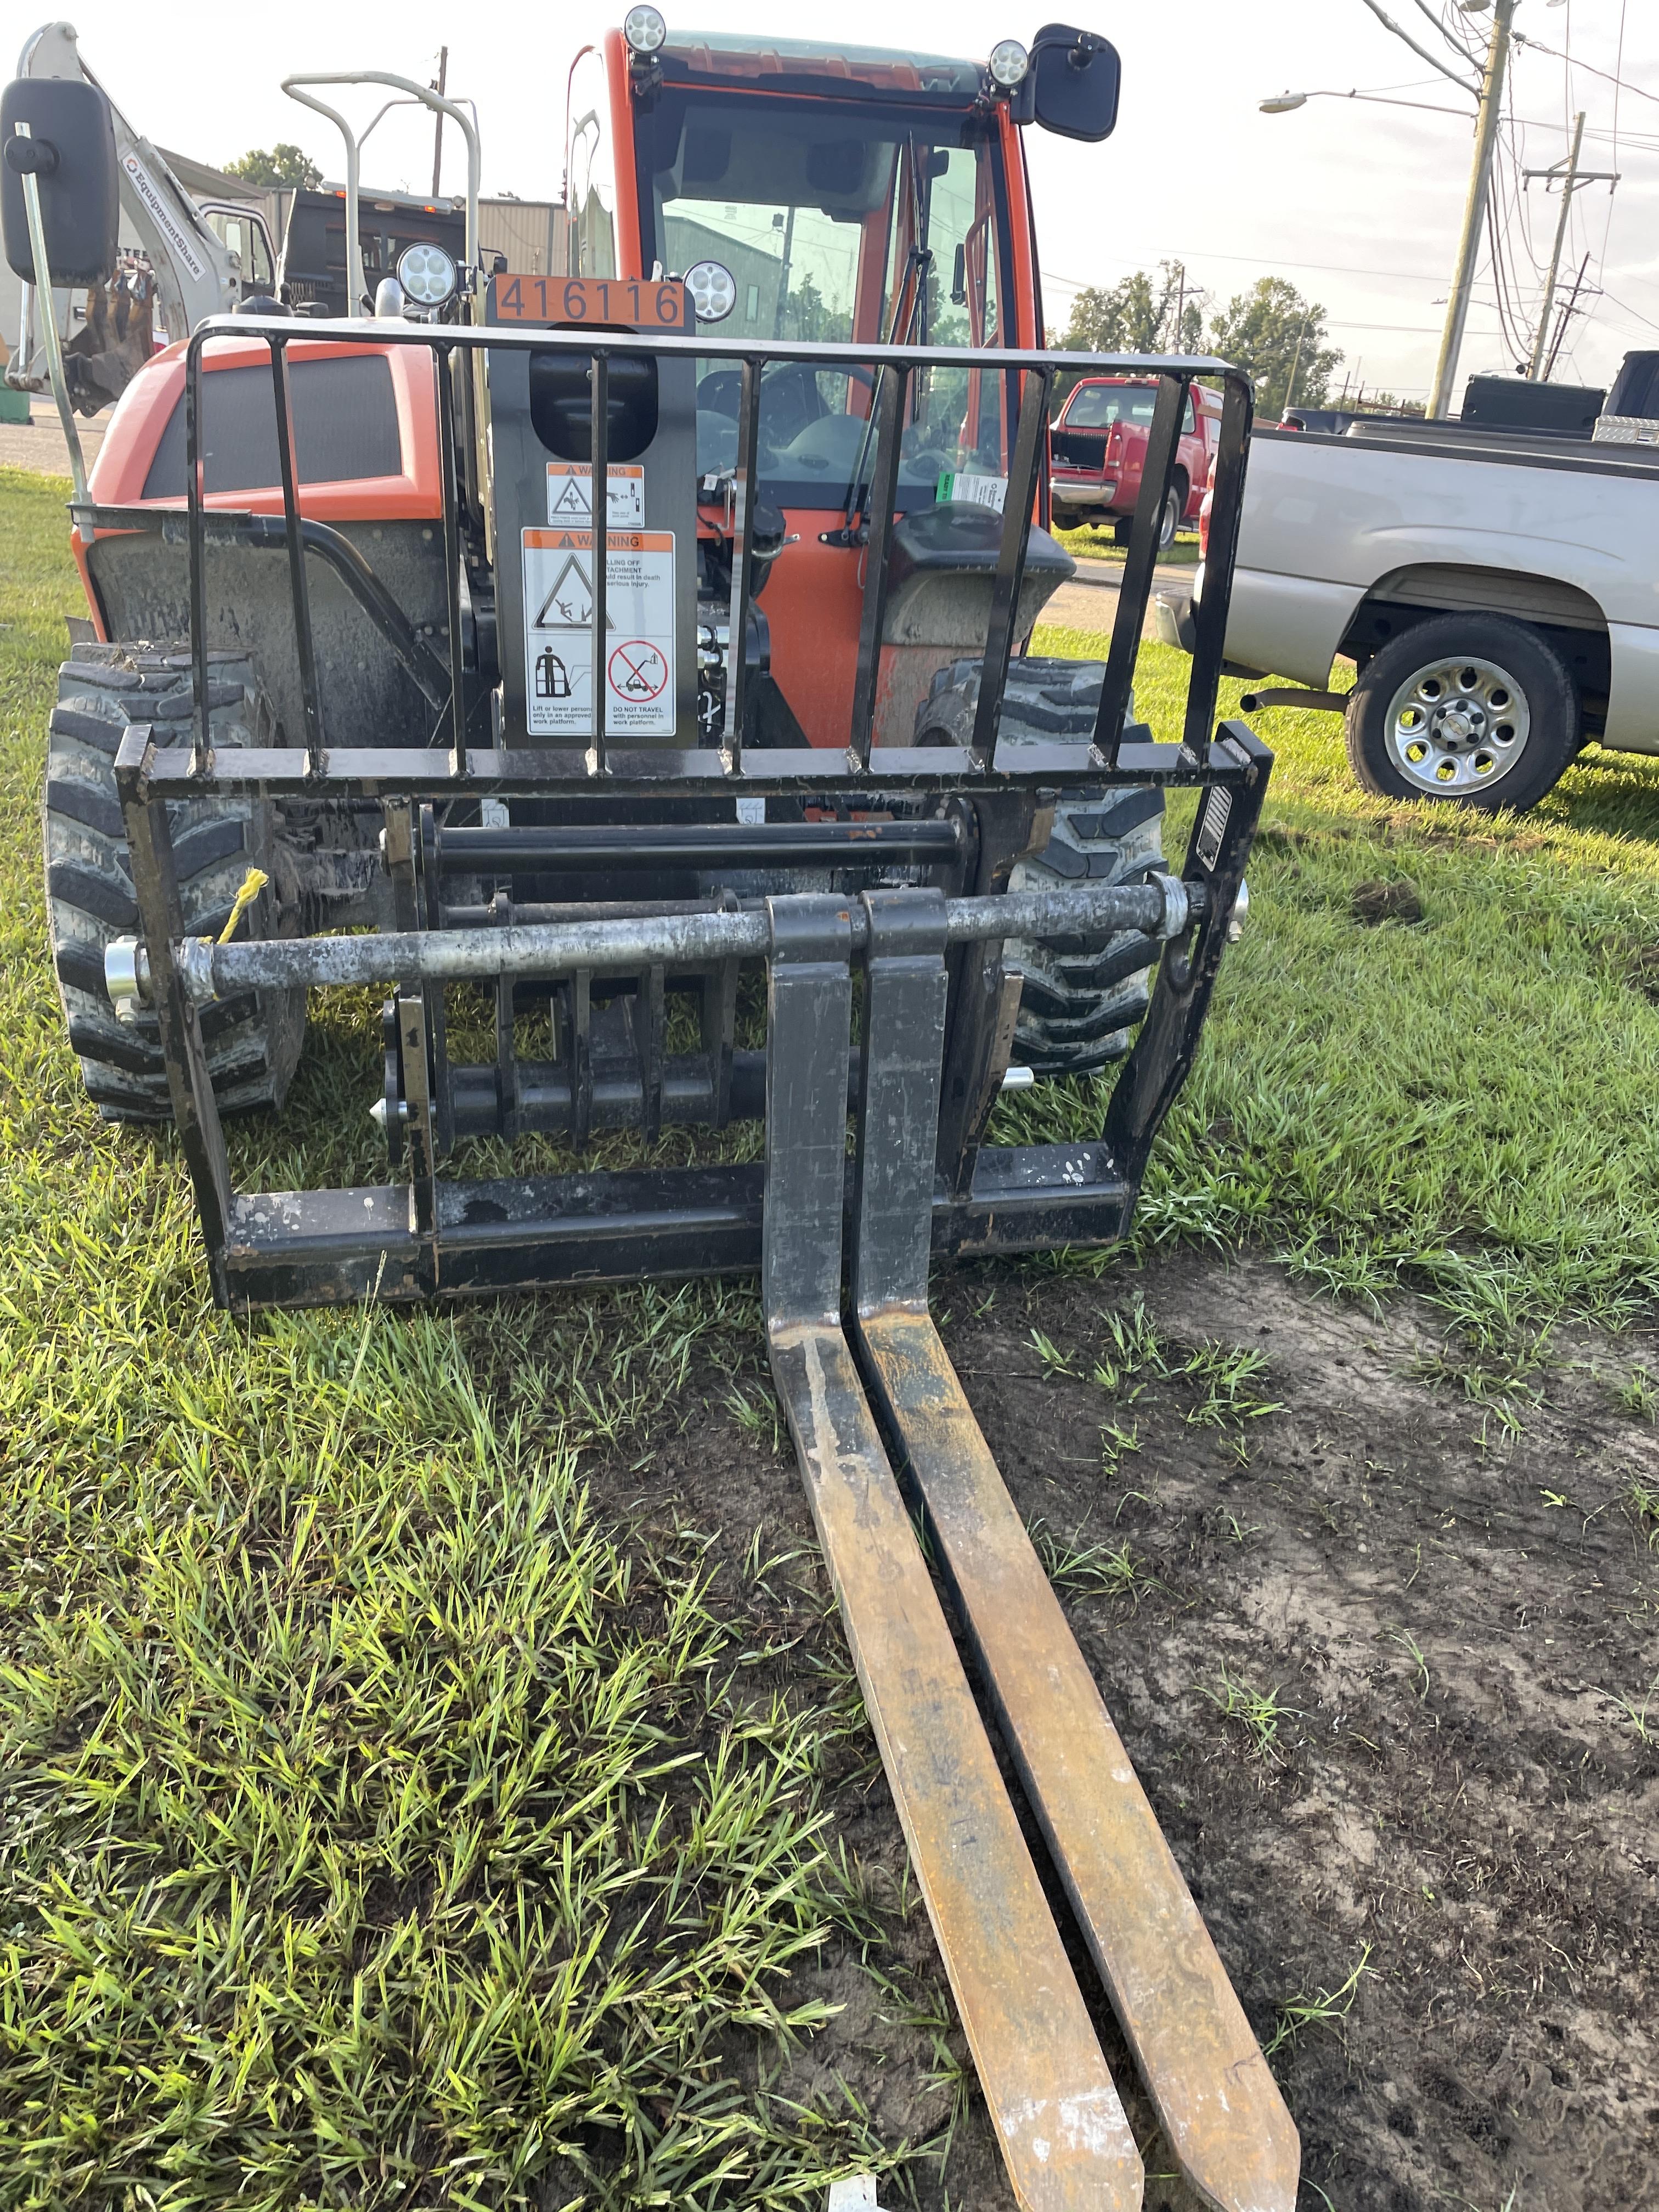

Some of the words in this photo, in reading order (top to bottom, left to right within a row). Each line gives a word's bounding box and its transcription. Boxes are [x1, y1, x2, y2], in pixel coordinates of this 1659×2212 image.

[135, 172, 200, 274] EquipmentShare
[501, 278, 678, 323] 416116
[579, 465, 625, 475] WAING
[577, 535, 639, 546] WNING
